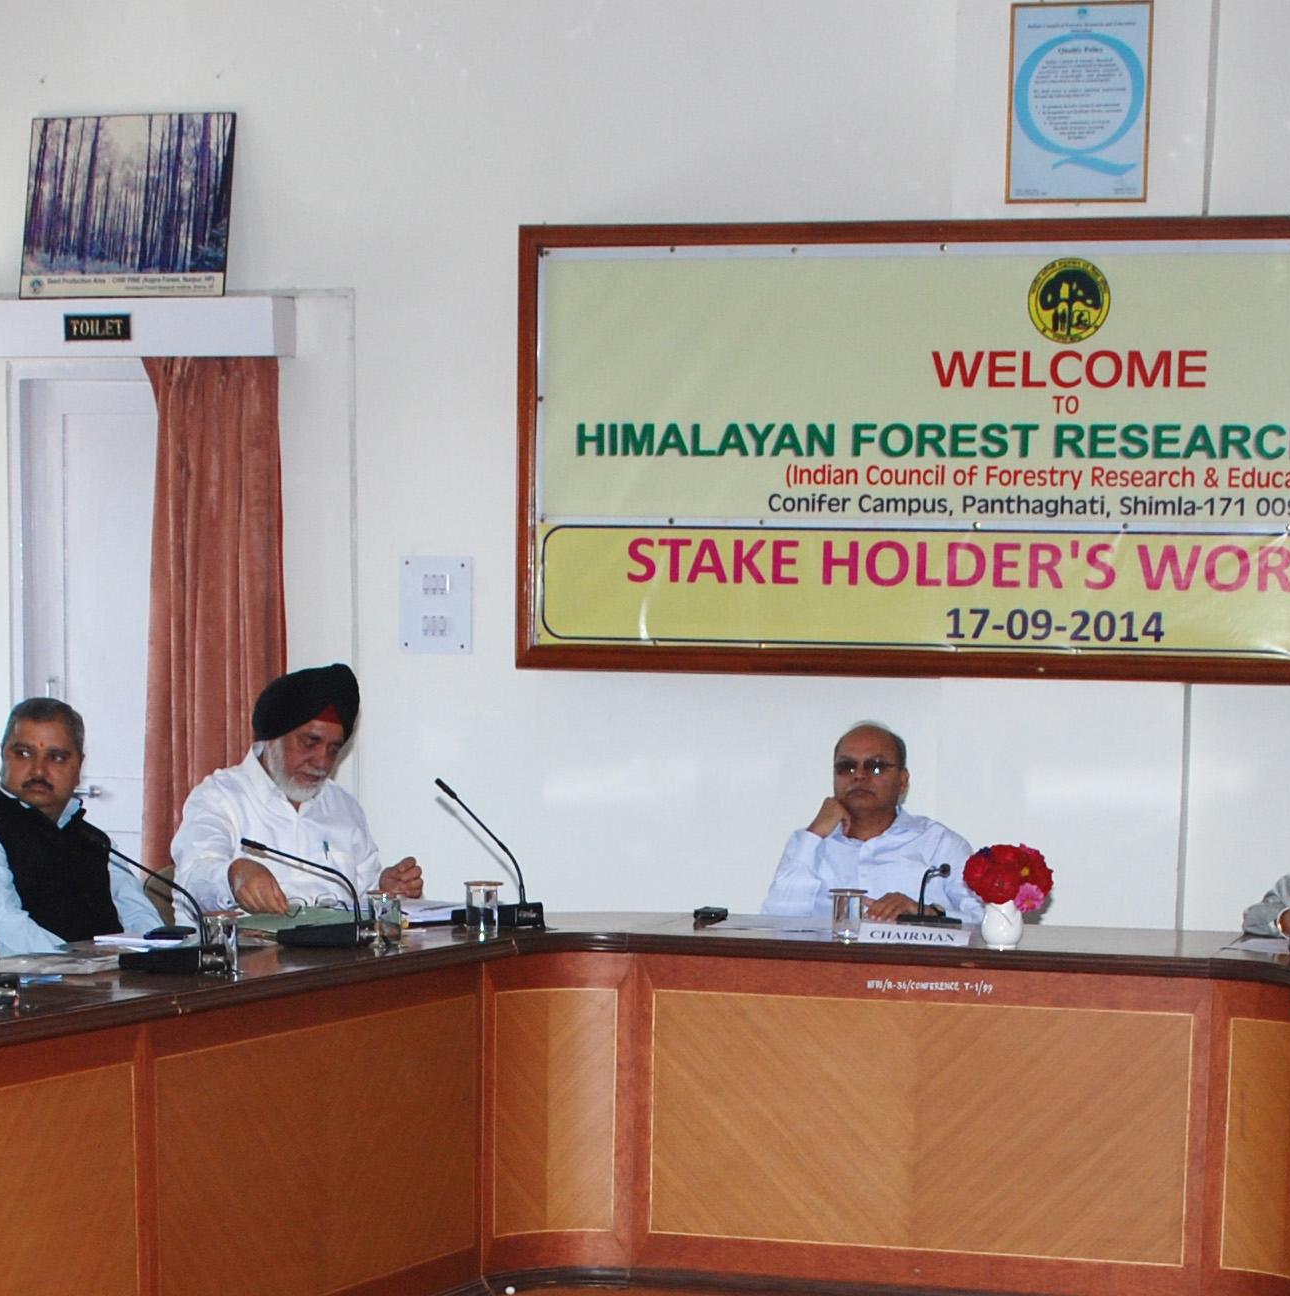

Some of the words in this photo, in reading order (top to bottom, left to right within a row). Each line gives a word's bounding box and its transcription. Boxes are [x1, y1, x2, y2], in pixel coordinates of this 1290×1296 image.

[70, 318, 124, 336] TOILET
[931, 350, 1208, 388] WELCOME
[1053, 396, 1079, 414] TO
[575, 423, 836, 458] HIMALAYAN
[852, 423, 1040, 459] FOREST
[785, 464, 859, 488] (Indian
[866, 464, 946, 487] Council
[952, 465, 978, 487] of
[985, 466, 1084, 493] Forestry
[1090, 466, 1196, 489] Research
[1202, 468, 1219, 489] &
[768, 493, 852, 514] Conifer
[858, 494, 954, 517] Campus,
[962, 495, 1111, 519] Panthaghati,
[1120, 496, 1246, 518] Shimla-171
[626, 537, 800, 585] STAKE
[822, 540, 1116, 591] HOLDER'S
[946, 608, 1165, 643] 17-09-2014
[869, 929, 956, 943] CHAIRMAN
